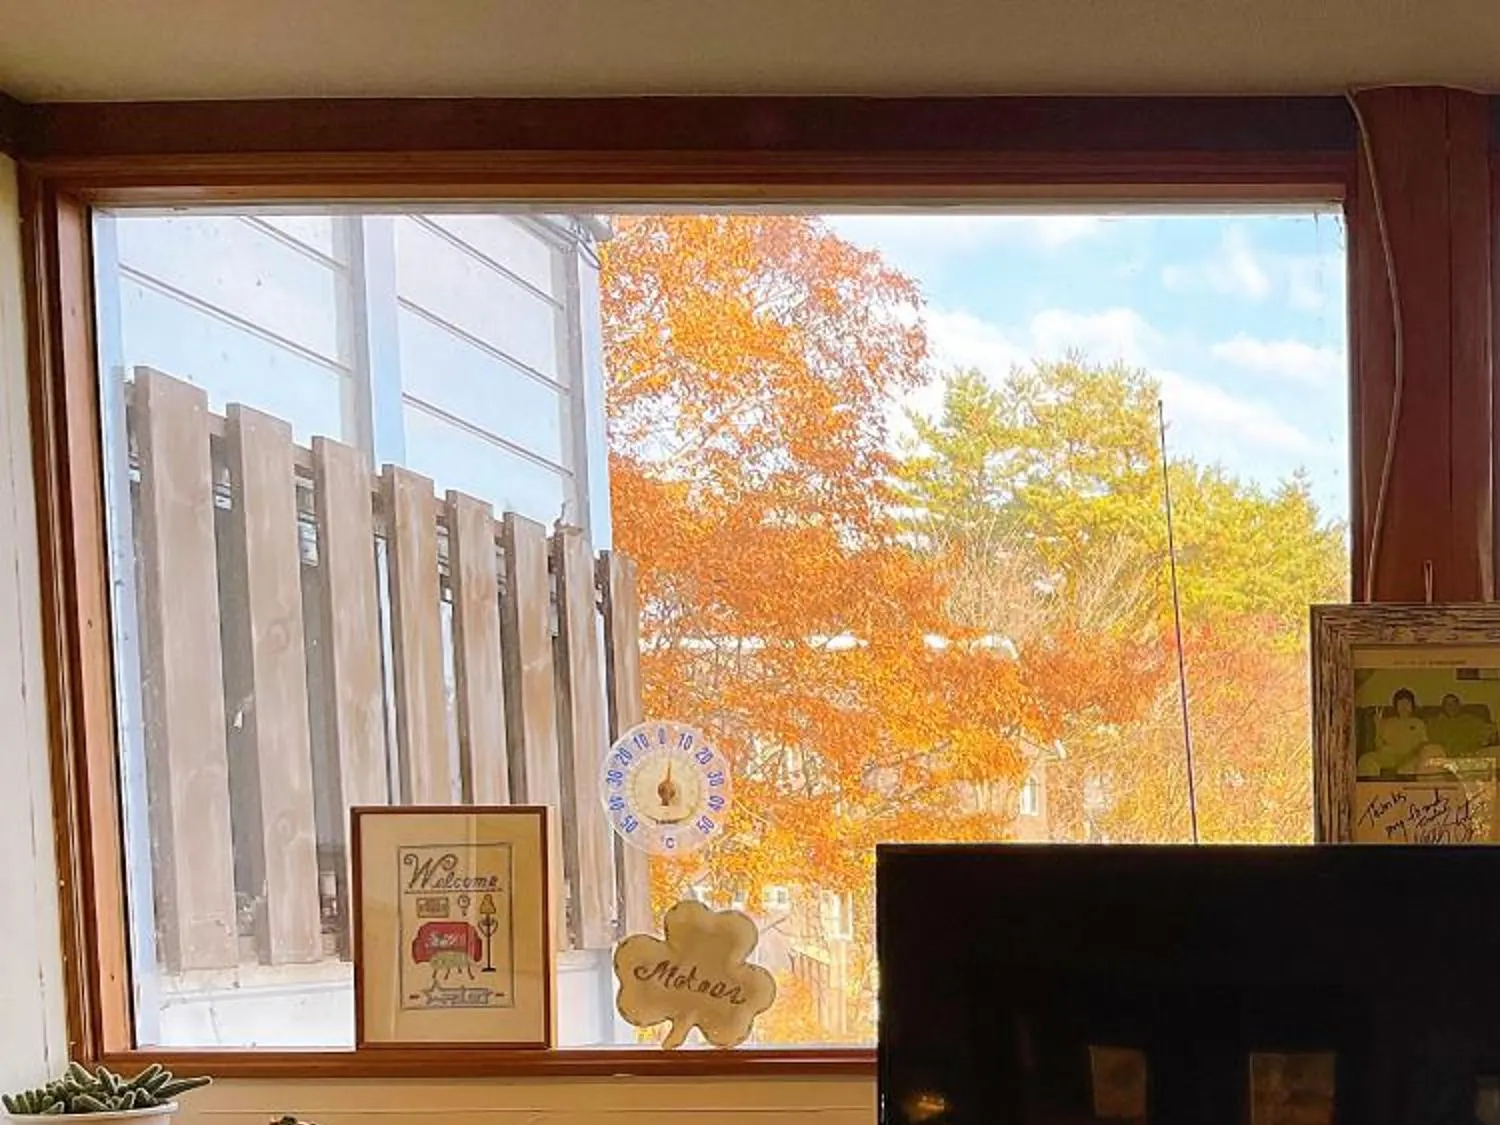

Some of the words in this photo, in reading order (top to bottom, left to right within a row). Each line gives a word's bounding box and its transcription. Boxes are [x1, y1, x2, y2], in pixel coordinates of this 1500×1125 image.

[677, 732, 694, 751] 10
[695, 746, 714, 765] 20
[706, 770, 725, 787] 30
[696, 814, 715, 835] 50
[403, 852, 500, 890] Welcome
